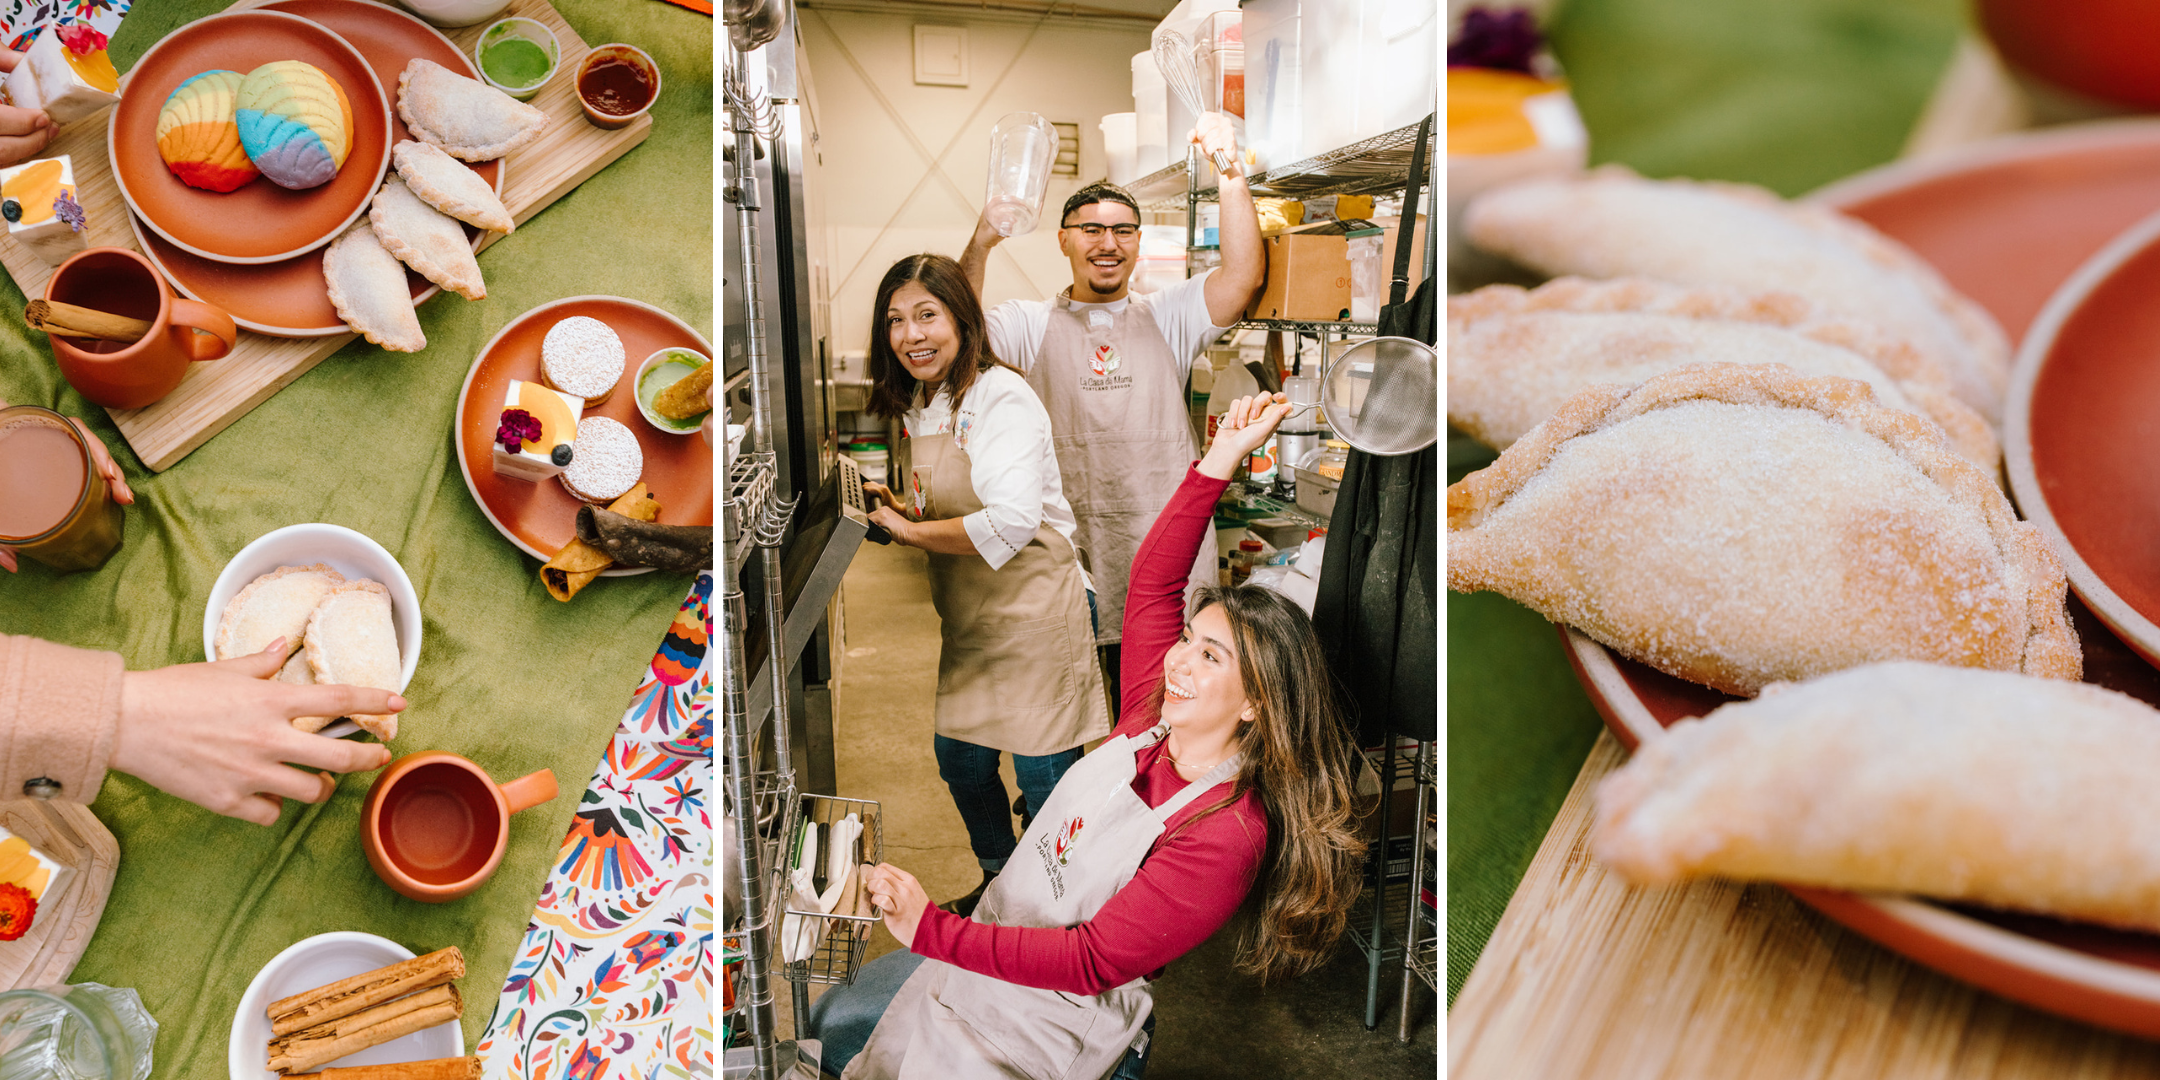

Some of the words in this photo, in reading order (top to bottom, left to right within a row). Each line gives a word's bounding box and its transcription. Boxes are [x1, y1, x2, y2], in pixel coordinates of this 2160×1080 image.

[1080, 377, 1087, 386] La
[1088, 377, 1104, 387] Casa
[1105, 377, 1112, 386] de
[1040, 832, 1049, 848] La
